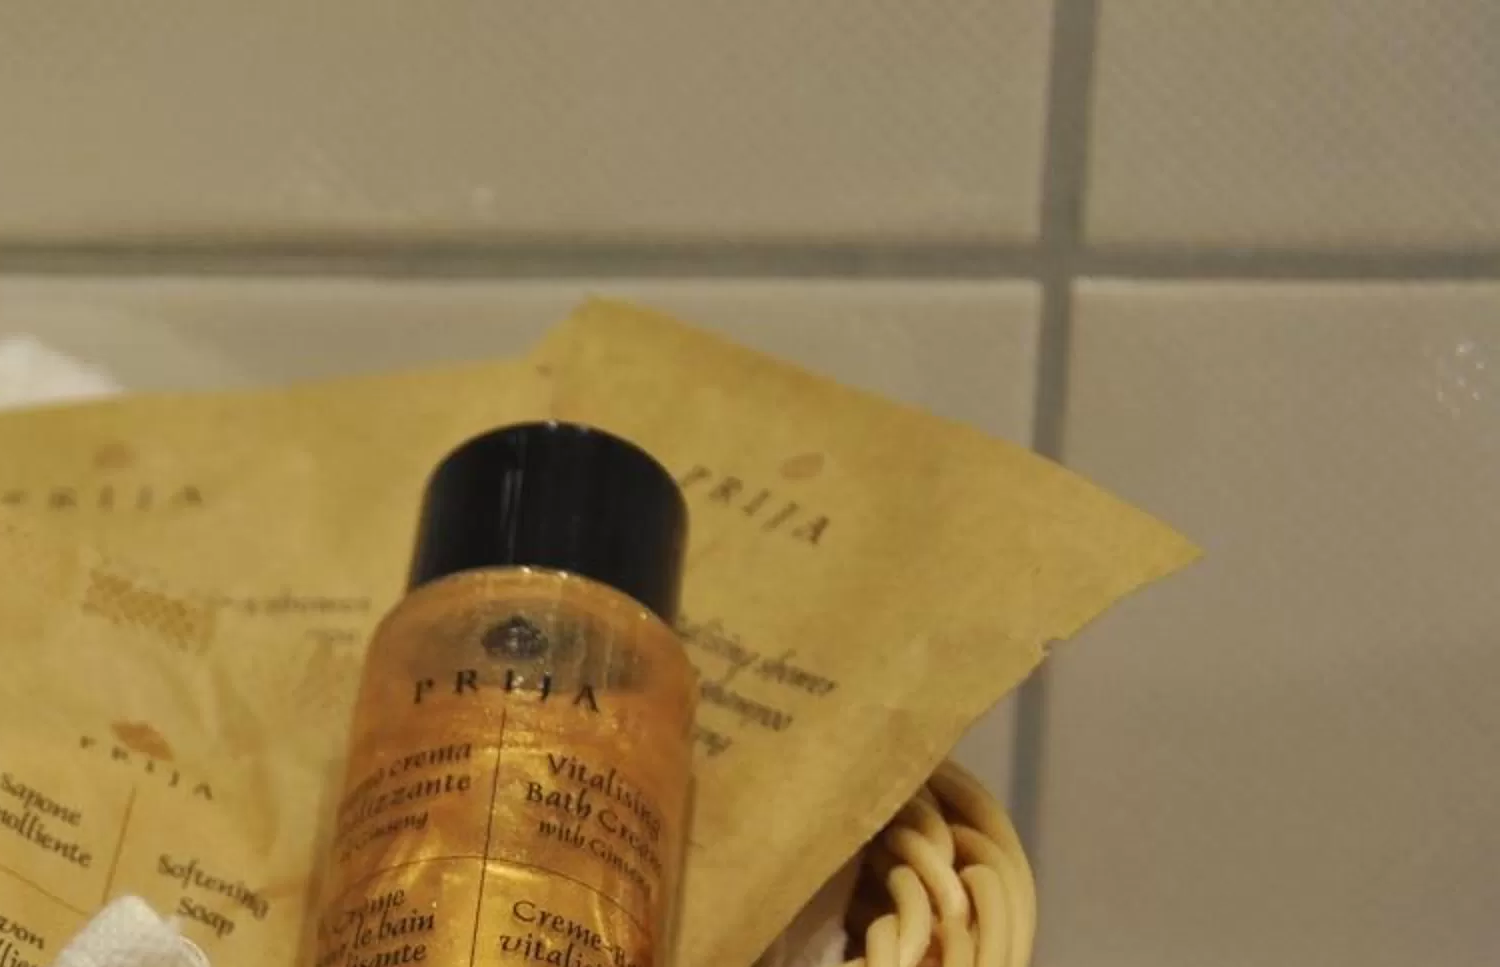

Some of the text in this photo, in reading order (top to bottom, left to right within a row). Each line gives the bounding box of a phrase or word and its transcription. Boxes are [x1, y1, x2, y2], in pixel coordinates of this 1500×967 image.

[413, 668, 600, 713] PRIJA
[525, 781, 592, 820] Bath
[539, 820, 586, 849] with
[156, 853, 270, 920] Softening
[176, 897, 235, 938] Soap
[378, 906, 437, 942] bain
